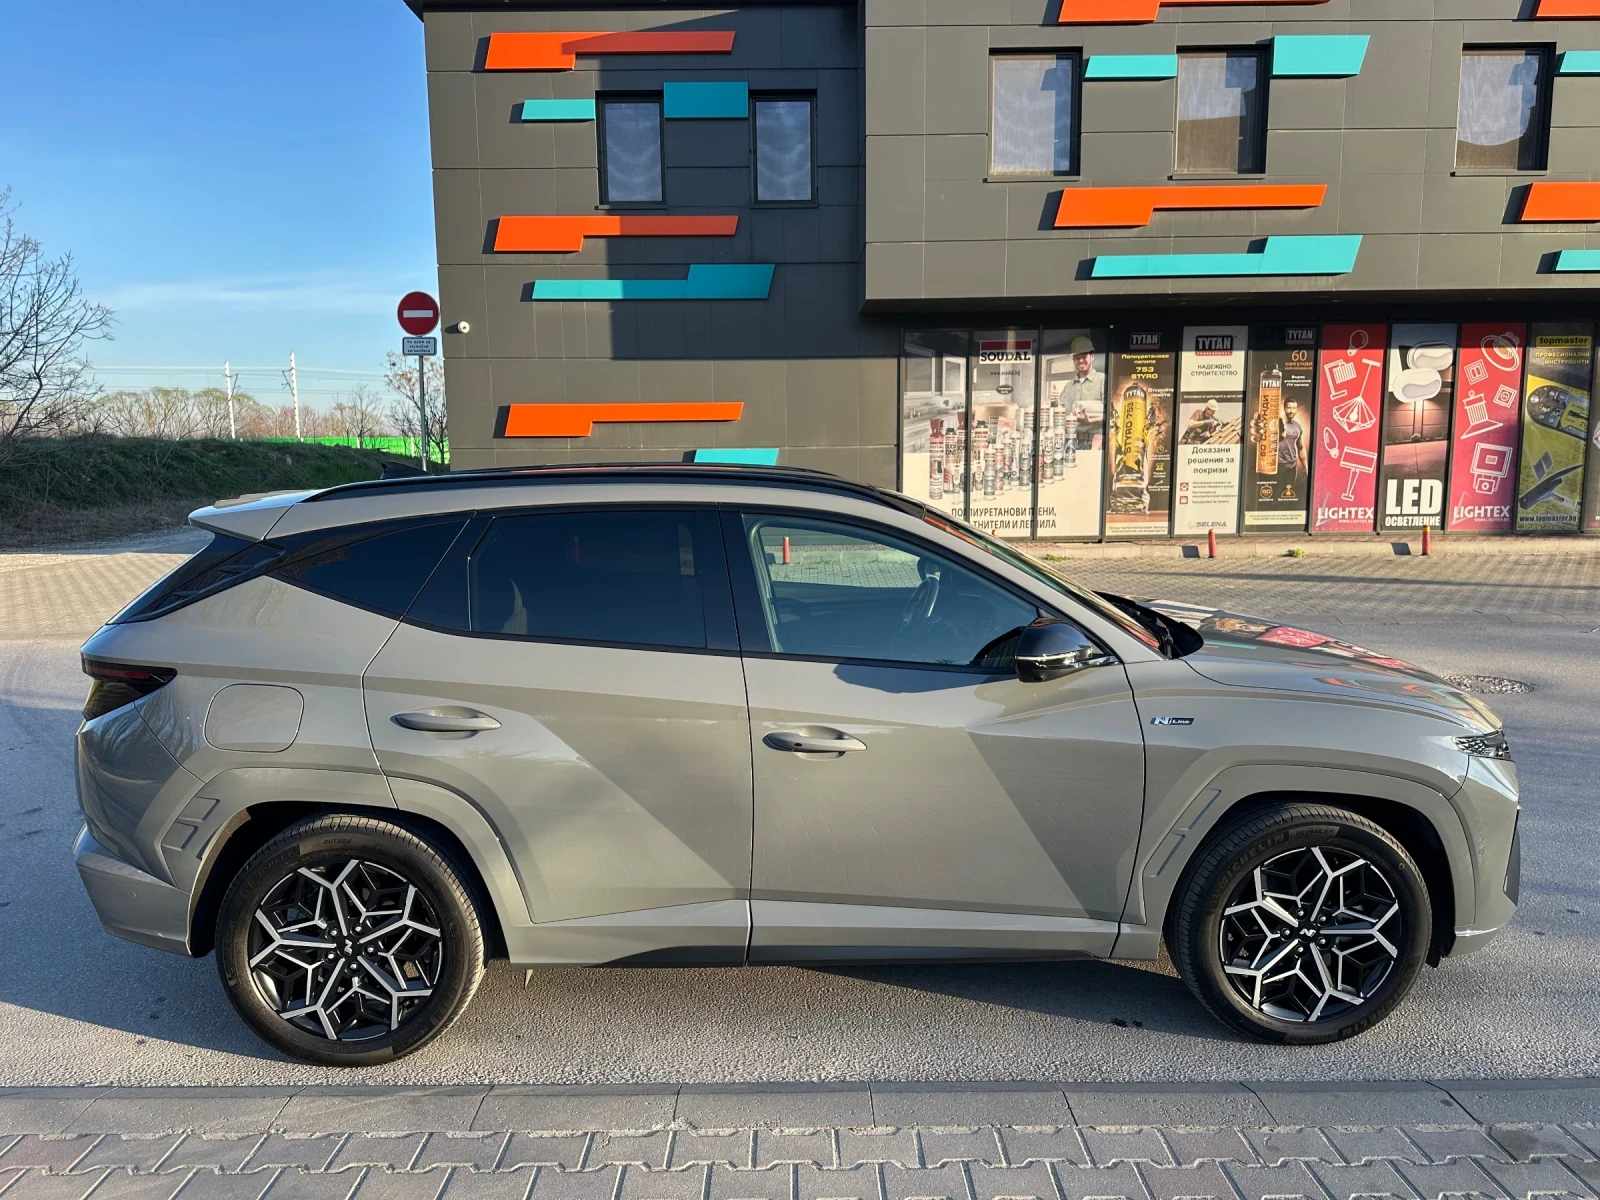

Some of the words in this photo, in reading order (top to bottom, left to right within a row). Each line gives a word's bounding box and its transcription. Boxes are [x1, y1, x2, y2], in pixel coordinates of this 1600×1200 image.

[1132, 334, 1158, 344] TYTAN
[1288, 330, 1313, 340] TYTAN
[1198, 337, 1231, 349] TYTAN
[1540, 336, 1588, 345] topmaster
[980, 352, 1031, 362] SOUDAL
[1291, 350, 1308, 362] 60
[1262, 380, 1281, 388] TYTAN
[1125, 389, 1145, 399] TYTAN
[1124, 421, 1133, 454] STYRO
[1192, 446, 1231, 455] Доказани
[1188, 457, 1223, 466] решения
[1193, 467, 1228, 475] покриви
[1385, 479, 1443, 515] LED
[1317, 506, 1375, 519] LIGHTEX
[1453, 505, 1511, 518] LIGHTEX
[1385, 515, 1441, 527] ОСВЕТЛЕНИЕ
[1519, 514, 1578, 523] www.topmaster.bg
[973, 520, 1010, 529] ТНИТЕЛИ
[1012, 520, 1018, 528] И
[1218, 834, 1285, 891] MICHELIN
[1295, 828, 1328, 837] PRIMACY
